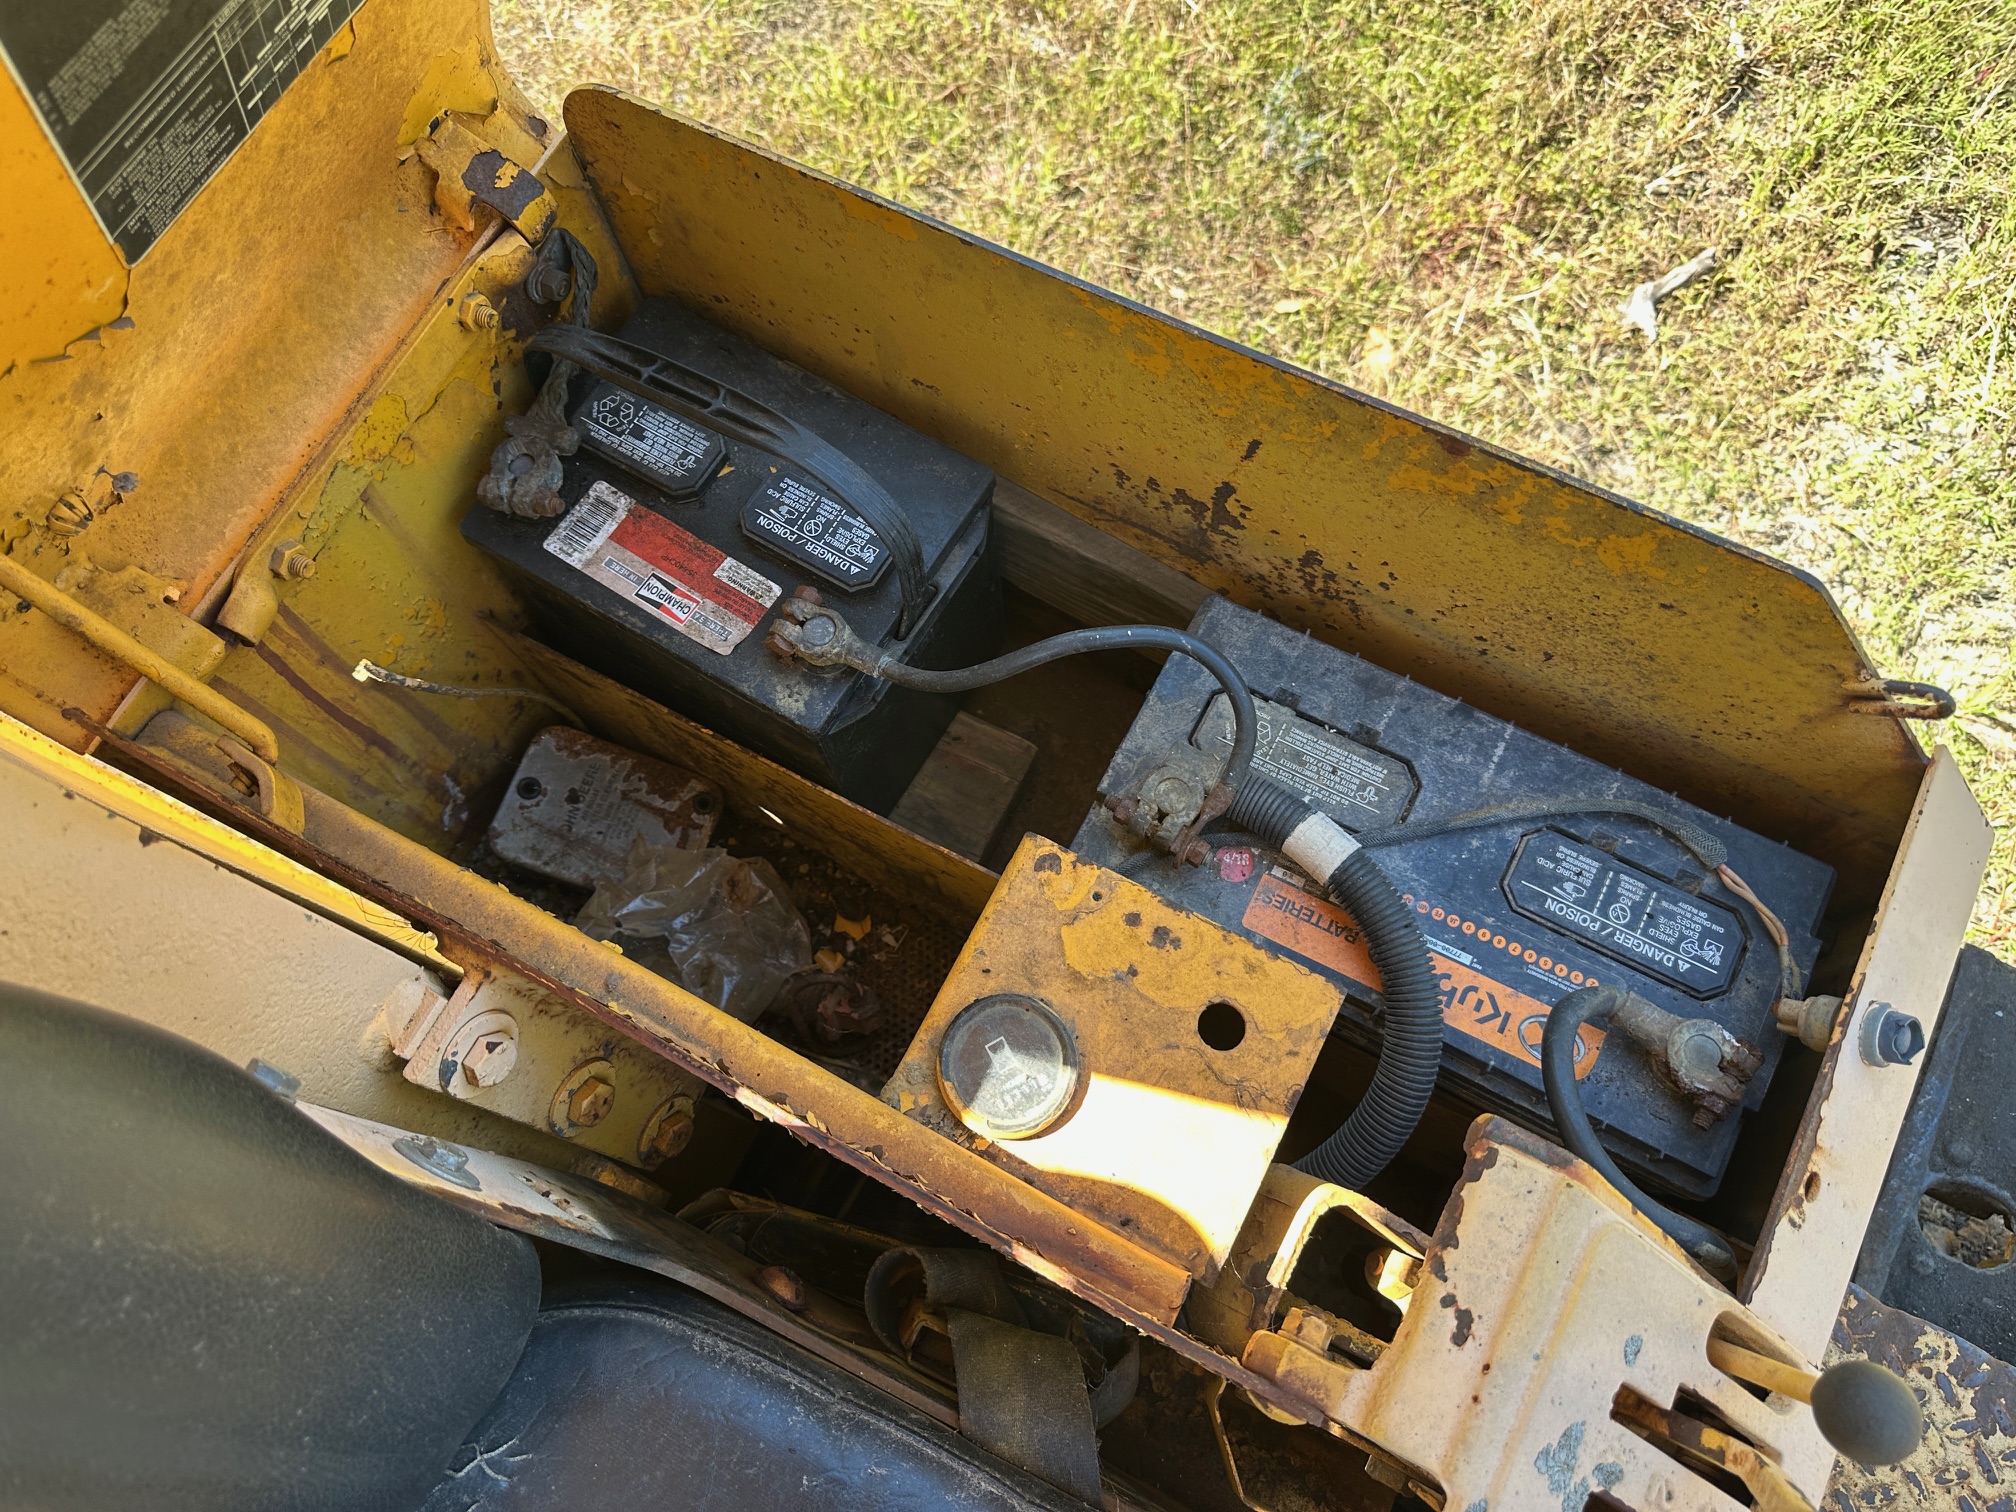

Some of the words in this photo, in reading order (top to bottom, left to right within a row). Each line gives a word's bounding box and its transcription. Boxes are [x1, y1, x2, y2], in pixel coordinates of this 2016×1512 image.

[122, 87, 177, 150] RECOMMENDED
[174, 43, 216, 92] LUBRICANTS
[121, 147, 148, 179] ENGINE
[144, 154, 192, 208] MULTIPURPOSE
[190, 124, 217, 157] GREASE
[589, 430, 612, 445] CHILDREN
[642, 429, 655, 439] FAST
[653, 435, 666, 445] HELP
[642, 437, 653, 445] GET
[664, 441, 683, 454] MEDICAL
[649, 447, 662, 457] EYES
[778, 481, 787, 489] OR
[783, 476, 799, 488] BURNS
[765, 487, 781, 499] ACID
[782, 489, 799, 501] CAUSE
[786, 484, 813, 502] BLINDNESS
[797, 484, 816, 497] SEVERE
[778, 494, 806, 512] SULFURIC
[797, 497, 809, 507] CAN
[814, 513, 826, 523] NO
[756, 514, 797, 542] POISON
[850, 526, 870, 540] GASES
[824, 535, 846, 550] SHIELD
[833, 533, 850, 545] EYES
[836, 526, 866, 546] EXPLOSIVE
[803, 540, 850, 570] DANGER
[608, 561, 630, 576] HERE
[627, 572, 638, 581] IN
[642, 581, 693, 615] CHAMPION
[698, 615, 729, 637] THERES
[1283, 734, 1303, 747] FOLLOW
[1302, 743, 1325, 757] STARTING
[1326, 749, 1345, 761] VEHICLE
[1251, 756, 1265, 766] AND
[1301, 753, 1317, 765] FAST
[1324, 753, 1338, 763] JUMP
[1337, 759, 1350, 769] SAFE
[1263, 762, 1279, 773] TIGHT
[1278, 757, 1318, 780] IMMEDIATELY
[1304, 761, 1318, 772] GET
[1316, 760, 1333, 772] HELP
[1276, 774, 1294, 785] REACH
[1277, 769, 1292, 779] CAPS
[1291, 775, 1306, 785] VENT
[1292, 781, 1304, 790] THE
[1305, 781, 1319, 791] KEEP
[1333, 782, 1355, 796] FLUSH
[1339, 778, 1358, 790] WITH
[1310, 789, 1323, 799] OUT
[1322, 795, 1336, 805] KEEP
[1328, 792, 1341, 801] NOT
[558, 805, 582, 832] OHN
[1555, 850, 1565, 859] OR
[1557, 844, 1577, 857] BURNS
[1535, 855, 1555, 869] ACID
[1560, 860, 1581, 873] CAUSE
[1565, 854, 1596, 873] BLINDNESS
[1576, 853, 1599, 867] SEVERE
[1554, 864, 1592, 886] SULFURIC
[1619, 895, 1632, 906] NO
[1677, 900, 1699, 914] INJURY
[1432, 909, 1443, 918] FE
[1543, 897, 1601, 931] POISON
[1660, 899, 1692, 918] BLINDNESS
[1259, 887, 1360, 945] BATTERIES
[1448, 916, 1458, 925] JA
[1691, 913, 1711, 927] CAUSE
[1657, 914, 1699, 939] EXPLOSIVE
[1675, 914, 1702, 932] GASES
[1710, 922, 1724, 933] CAN
[1647, 927, 1676, 945] SHIELD
[1658, 922, 1679, 938] EYES
[1612, 929, 1675, 966] DANGER
